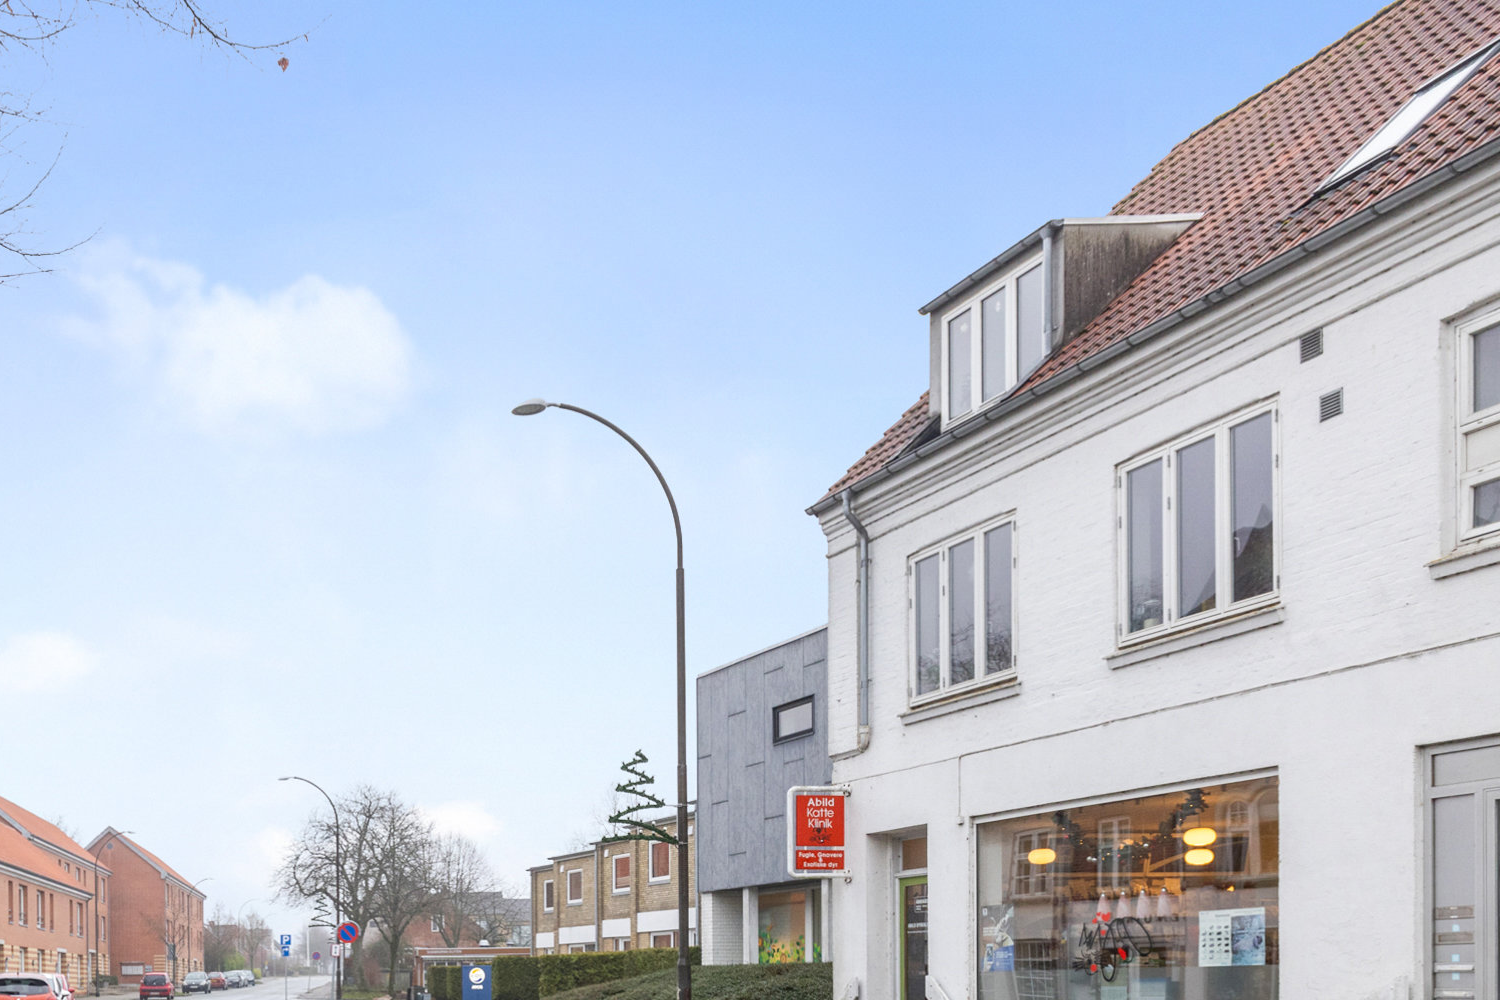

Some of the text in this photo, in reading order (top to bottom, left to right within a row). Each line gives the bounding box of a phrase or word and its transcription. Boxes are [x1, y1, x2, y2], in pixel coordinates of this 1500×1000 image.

[807, 798, 835, 807] Abild
[806, 808, 835, 818] Katte
[808, 818, 833, 829] Klinik
[828, 861, 838, 869] dyr
[282, 936, 290, 945] P
